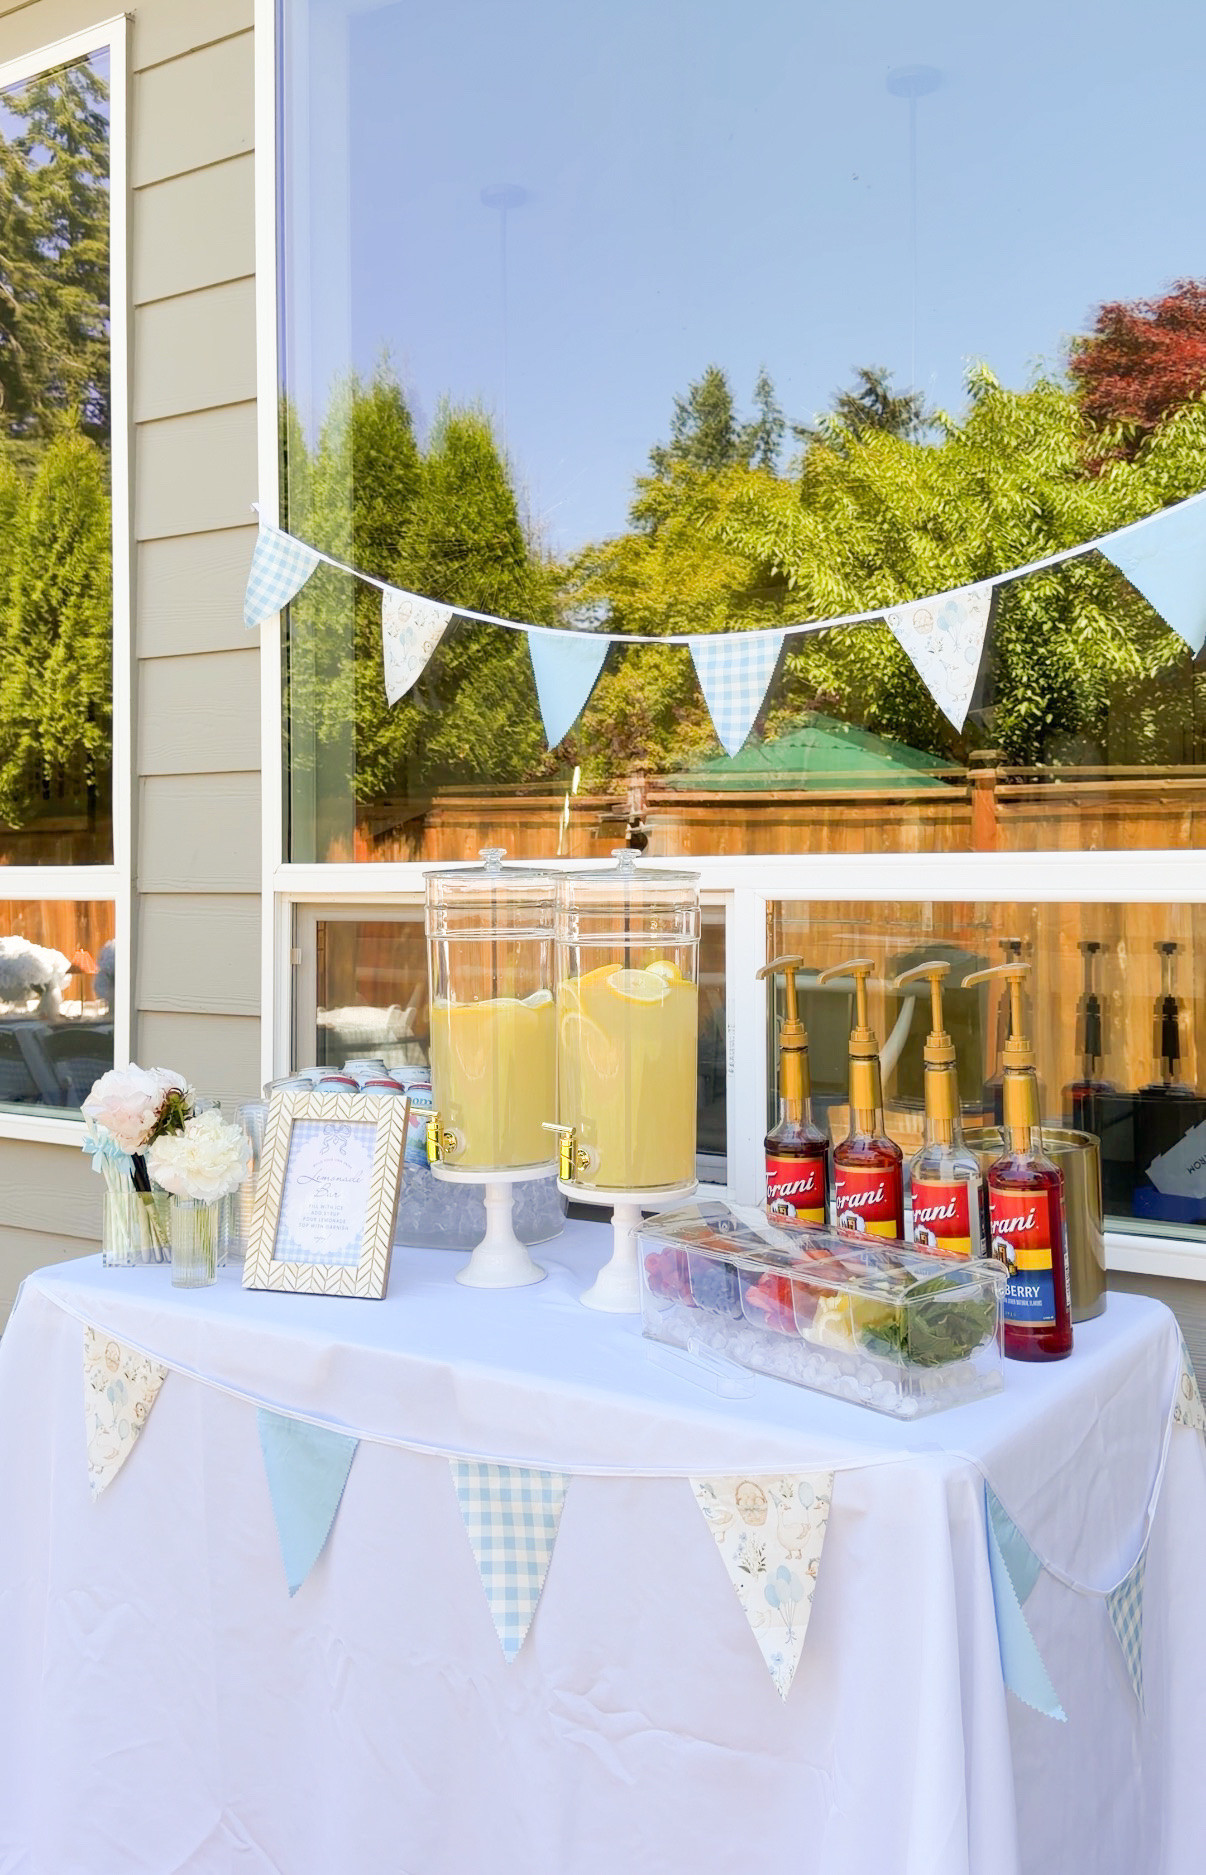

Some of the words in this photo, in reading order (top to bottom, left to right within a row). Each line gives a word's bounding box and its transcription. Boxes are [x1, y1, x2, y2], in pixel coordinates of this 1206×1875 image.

[911, 1194, 957, 1223] rani
[989, 1205, 1036, 1235] rani
[1005, 1284, 1040, 1298] BERRY
